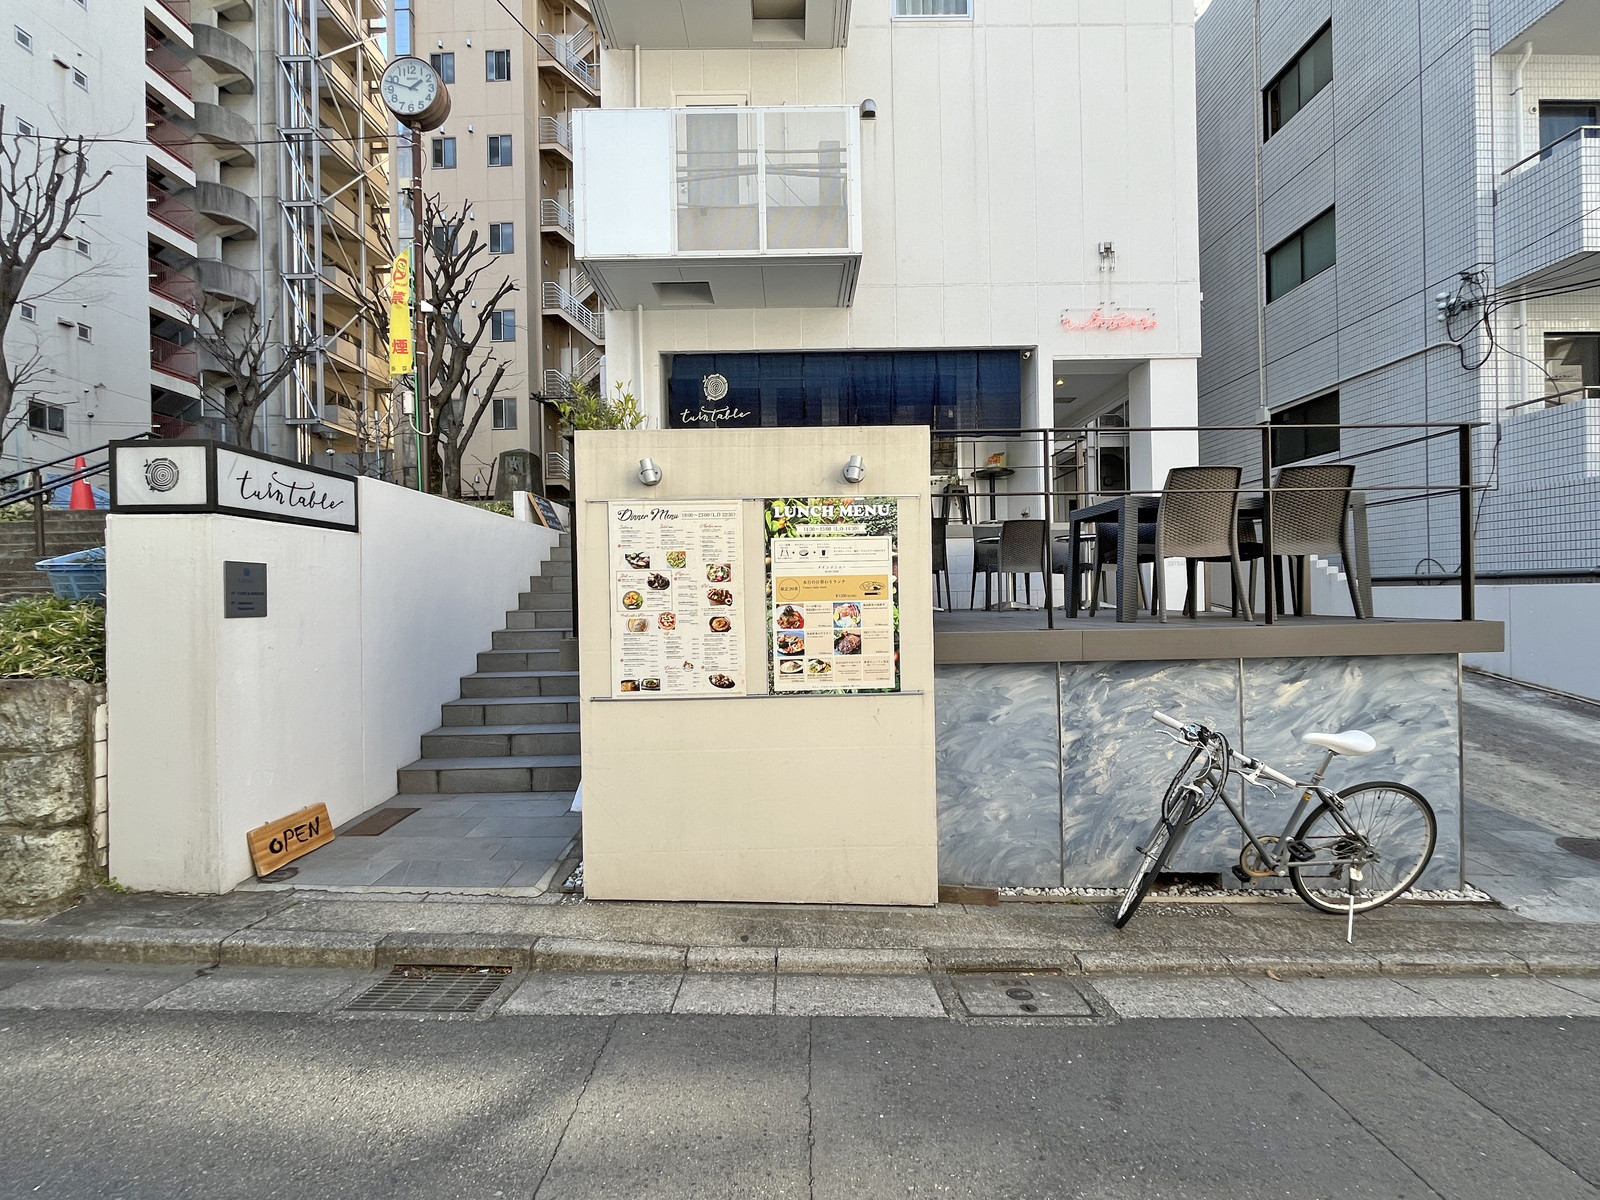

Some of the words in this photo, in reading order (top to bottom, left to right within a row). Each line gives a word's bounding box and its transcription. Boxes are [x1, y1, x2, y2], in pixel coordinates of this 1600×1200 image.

[408, 66, 416, 74] 12
[388, 75, 399, 84] 10
[426, 74, 432, 82] 2
[388, 86, 394, 94] 9
[428, 84, 434, 92] 3
[391, 94, 398, 102] 8
[408, 104, 414, 112] 6
[418, 101, 424, 109] 5
[618, 508, 648, 521] Dinner
[651, 508, 678, 521] Menu
[774, 506, 835, 518] LUNCH
[840, 504, 891, 516] MENU
[269, 816, 320, 854] OPEN
